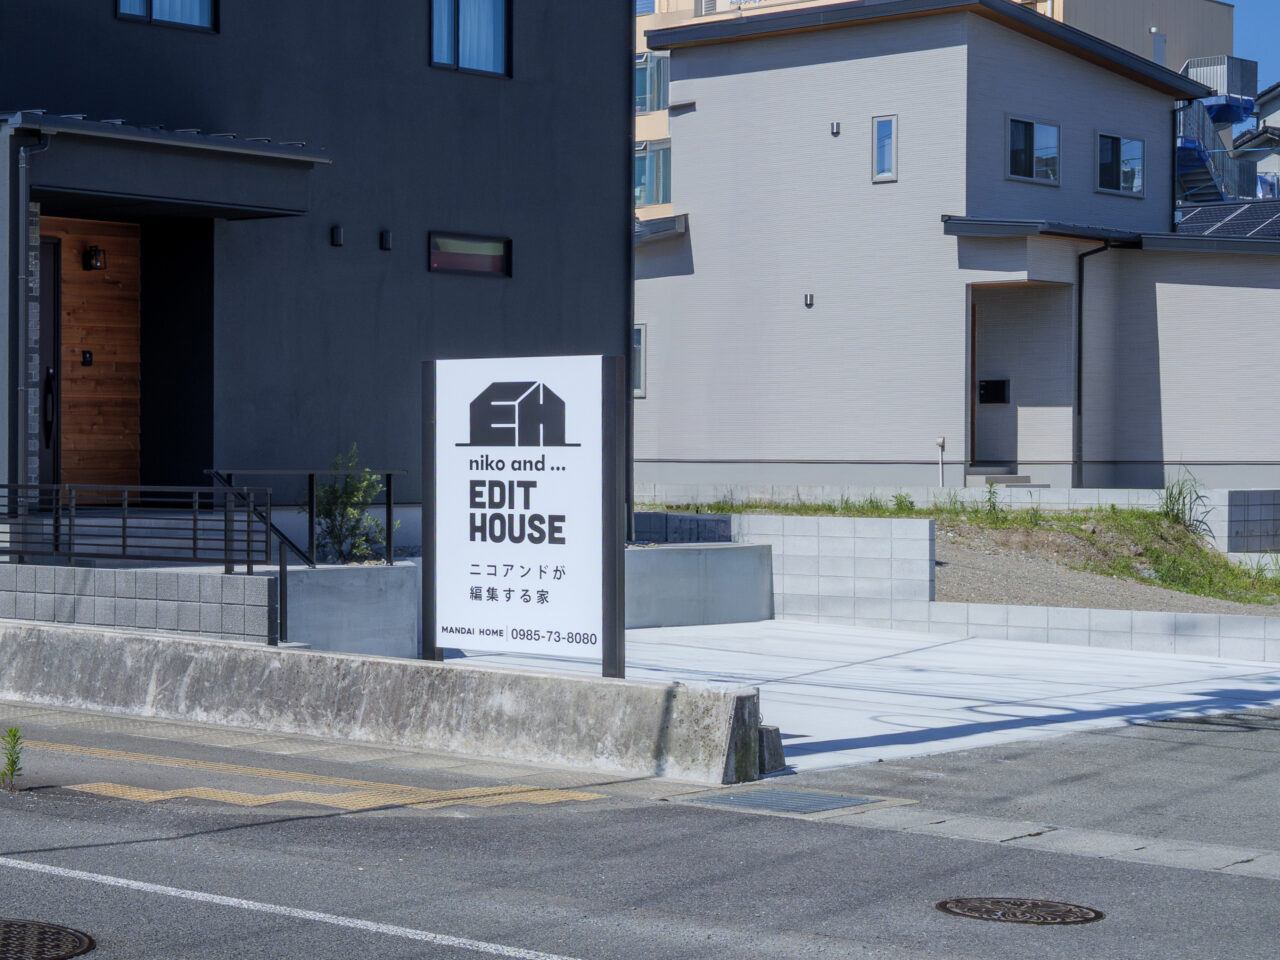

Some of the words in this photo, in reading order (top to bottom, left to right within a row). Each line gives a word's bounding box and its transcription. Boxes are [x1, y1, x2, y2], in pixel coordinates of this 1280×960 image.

[469, 454, 505, 471] niko
[469, 480, 537, 510] EDIT
[469, 512, 566, 544] HOUSE
[470, 564, 566, 580] ニコアンドが
[470, 586, 549, 604] 編集する家
[441, 626, 475, 635] MANDAI
[479, 628, 504, 637] HOME
[511, 628, 598, 645] 0985-73-8080
